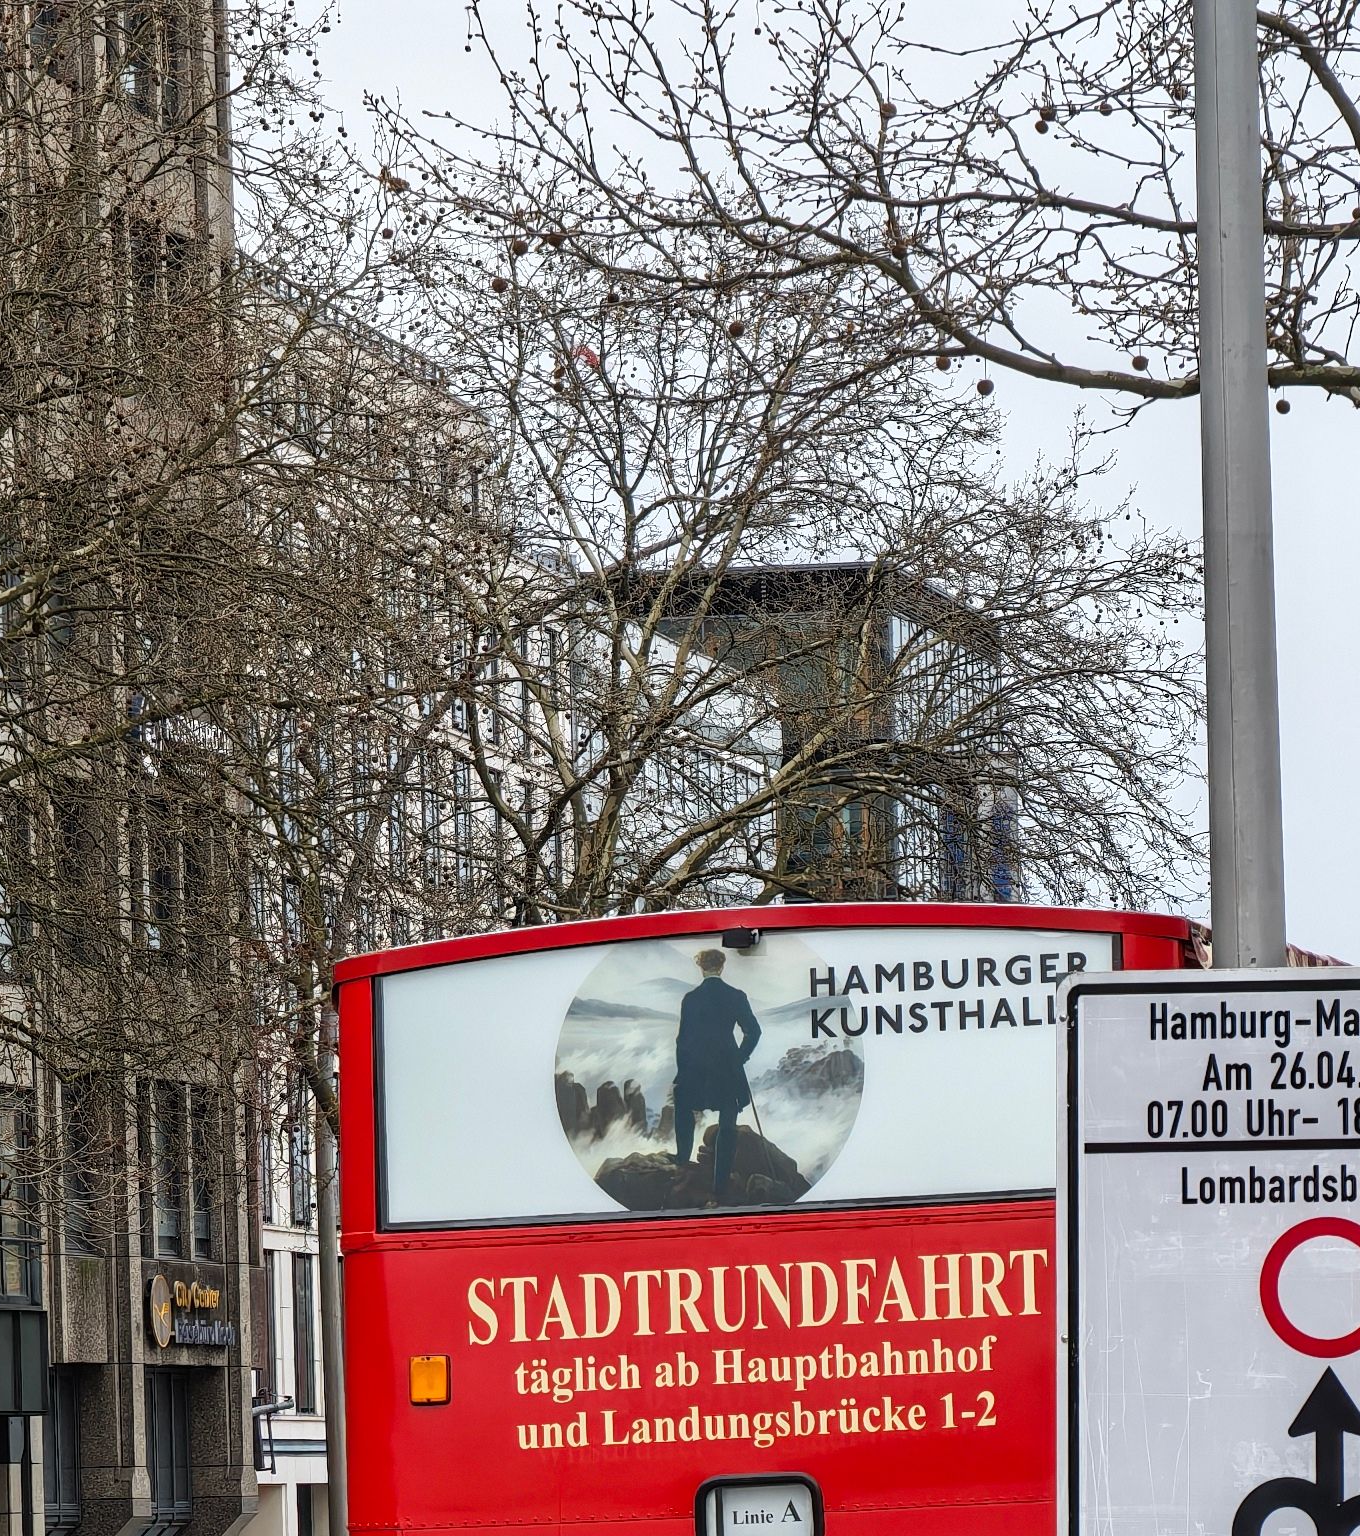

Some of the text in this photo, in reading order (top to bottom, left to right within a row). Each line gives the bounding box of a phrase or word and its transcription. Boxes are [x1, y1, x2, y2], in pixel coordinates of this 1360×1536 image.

[809, 952, 1088, 998] HAMBURGER
[810, 994, 1057, 1040] KUNSTHALL
[1202, 1053, 1252, 1091] Am
[1147, 1100, 1228, 1139] 07.00
[467, 1248, 1048, 1347] STADTRUNDFAHRT
[514, 1336, 998, 1402] täglich ab Hauptbahnhof
[516, 1391, 997, 1450] und Landungsbrücke 1-2
[732, 1499, 802, 1527] Linie A
